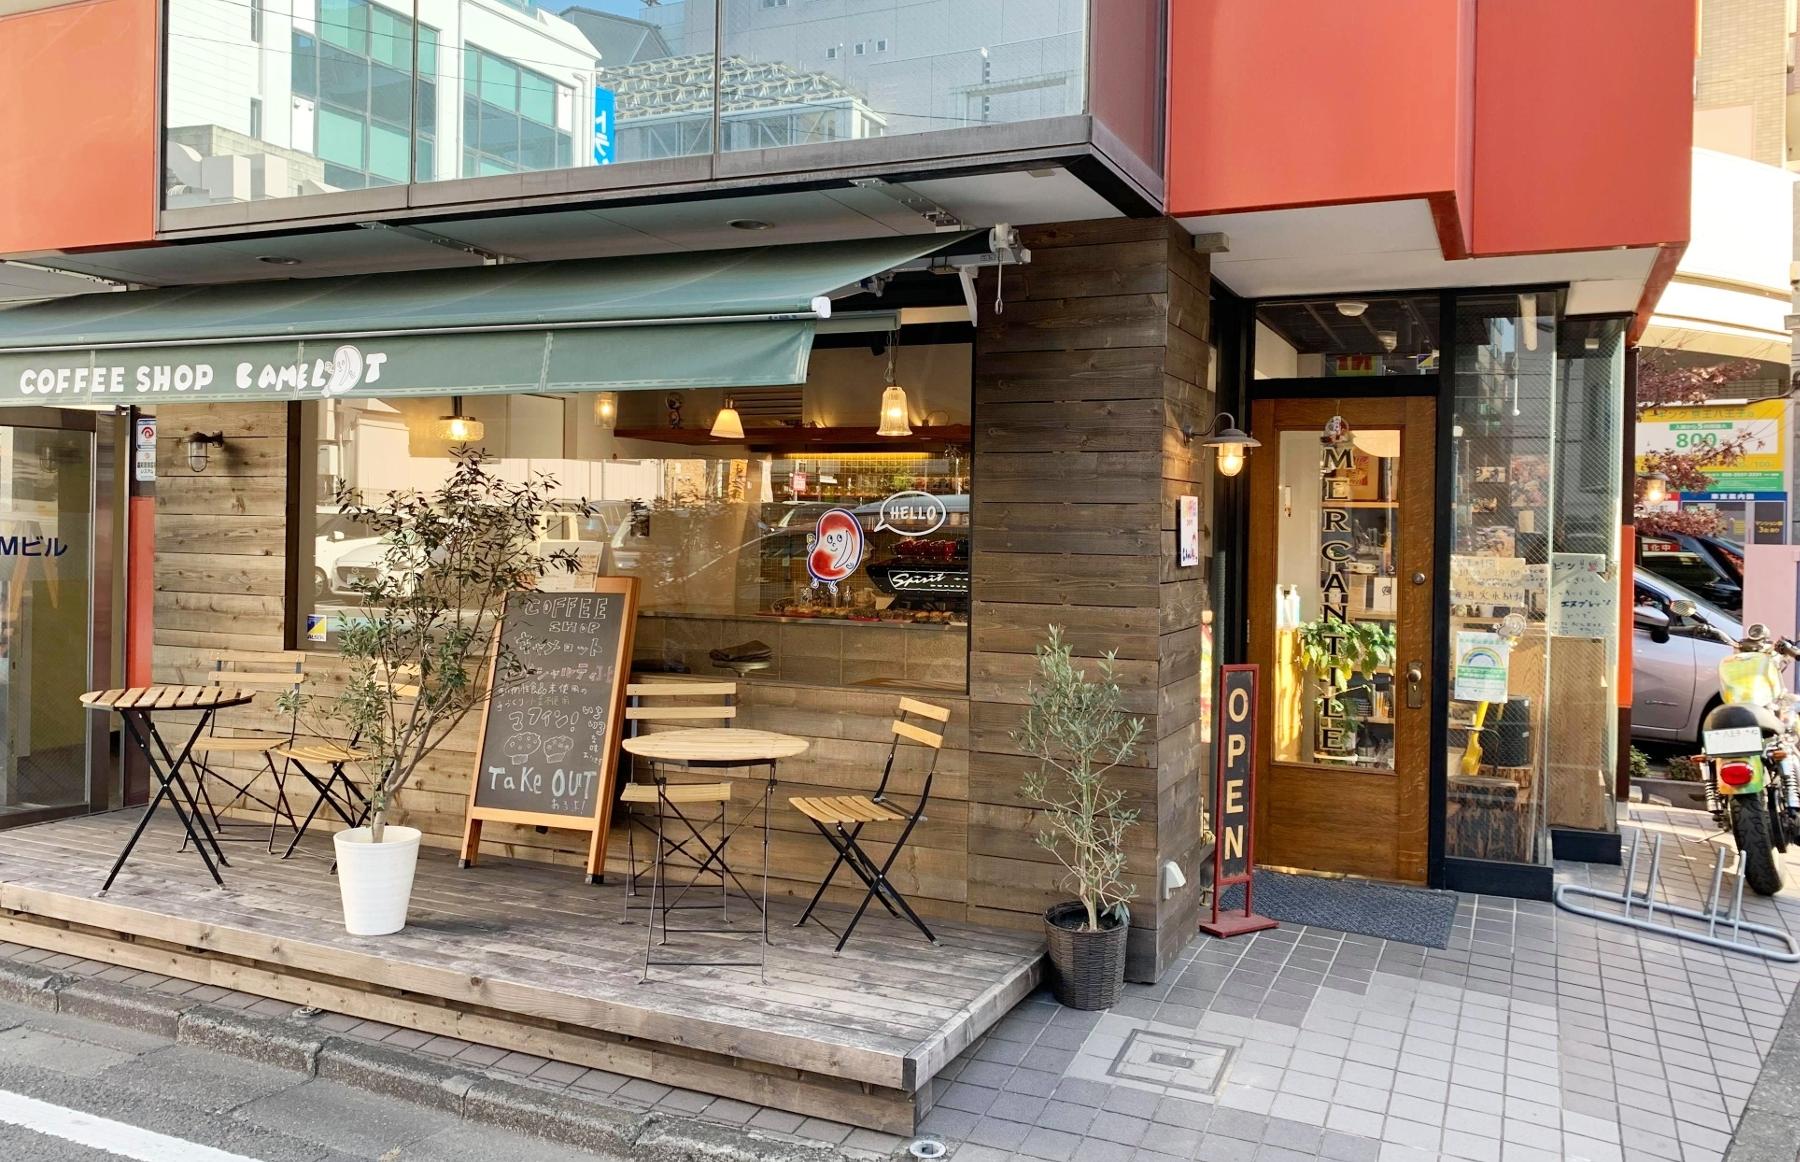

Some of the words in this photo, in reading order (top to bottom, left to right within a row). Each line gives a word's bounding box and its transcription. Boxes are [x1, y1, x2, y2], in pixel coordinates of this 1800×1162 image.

[19, 364, 126, 396] COFFEE
[135, 363, 215, 393] SHOP
[890, 506, 937, 520] HELLO
[892, 572, 947, 589] Spirit
[525, 597, 609, 620] COFFEE
[1321, 447, 1356, 751] MERCANTILE
[549, 621, 601, 634] SHOP
[515, 631, 602, 657] キャメロット
[551, 768, 597, 800] OUT
[1224, 687, 1249, 861] OPEN
